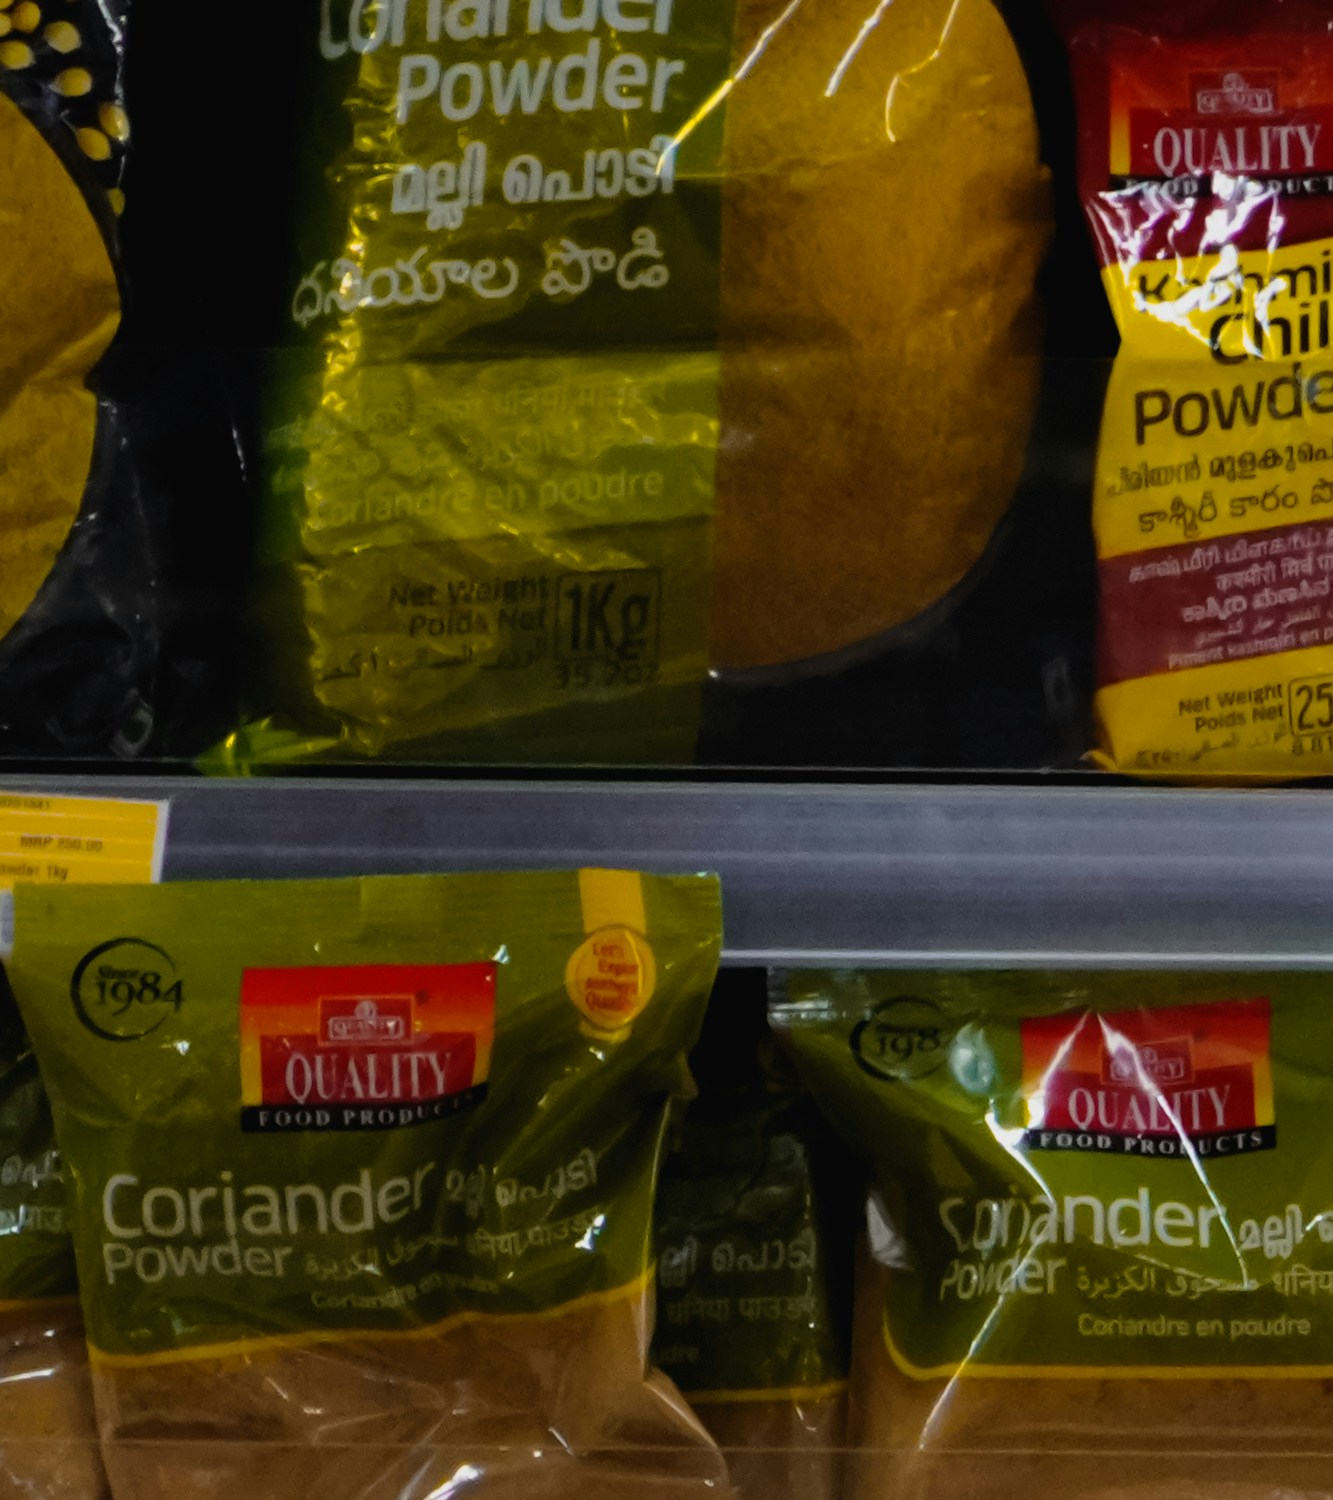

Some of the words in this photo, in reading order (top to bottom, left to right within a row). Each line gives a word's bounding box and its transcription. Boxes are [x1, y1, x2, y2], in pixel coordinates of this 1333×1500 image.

[396, 59, 685, 125] Powder
[1153, 123, 1323, 175] QUALITY
[388, 143, 486, 229] മല്ലി
[564, 576, 651, 664] 1Kg
[93, 976, 185, 1014] 1984
[285, 1051, 453, 1104] QUALITY
[100, 1162, 436, 1240] Coriander
[103, 1240, 294, 1286] Powder
